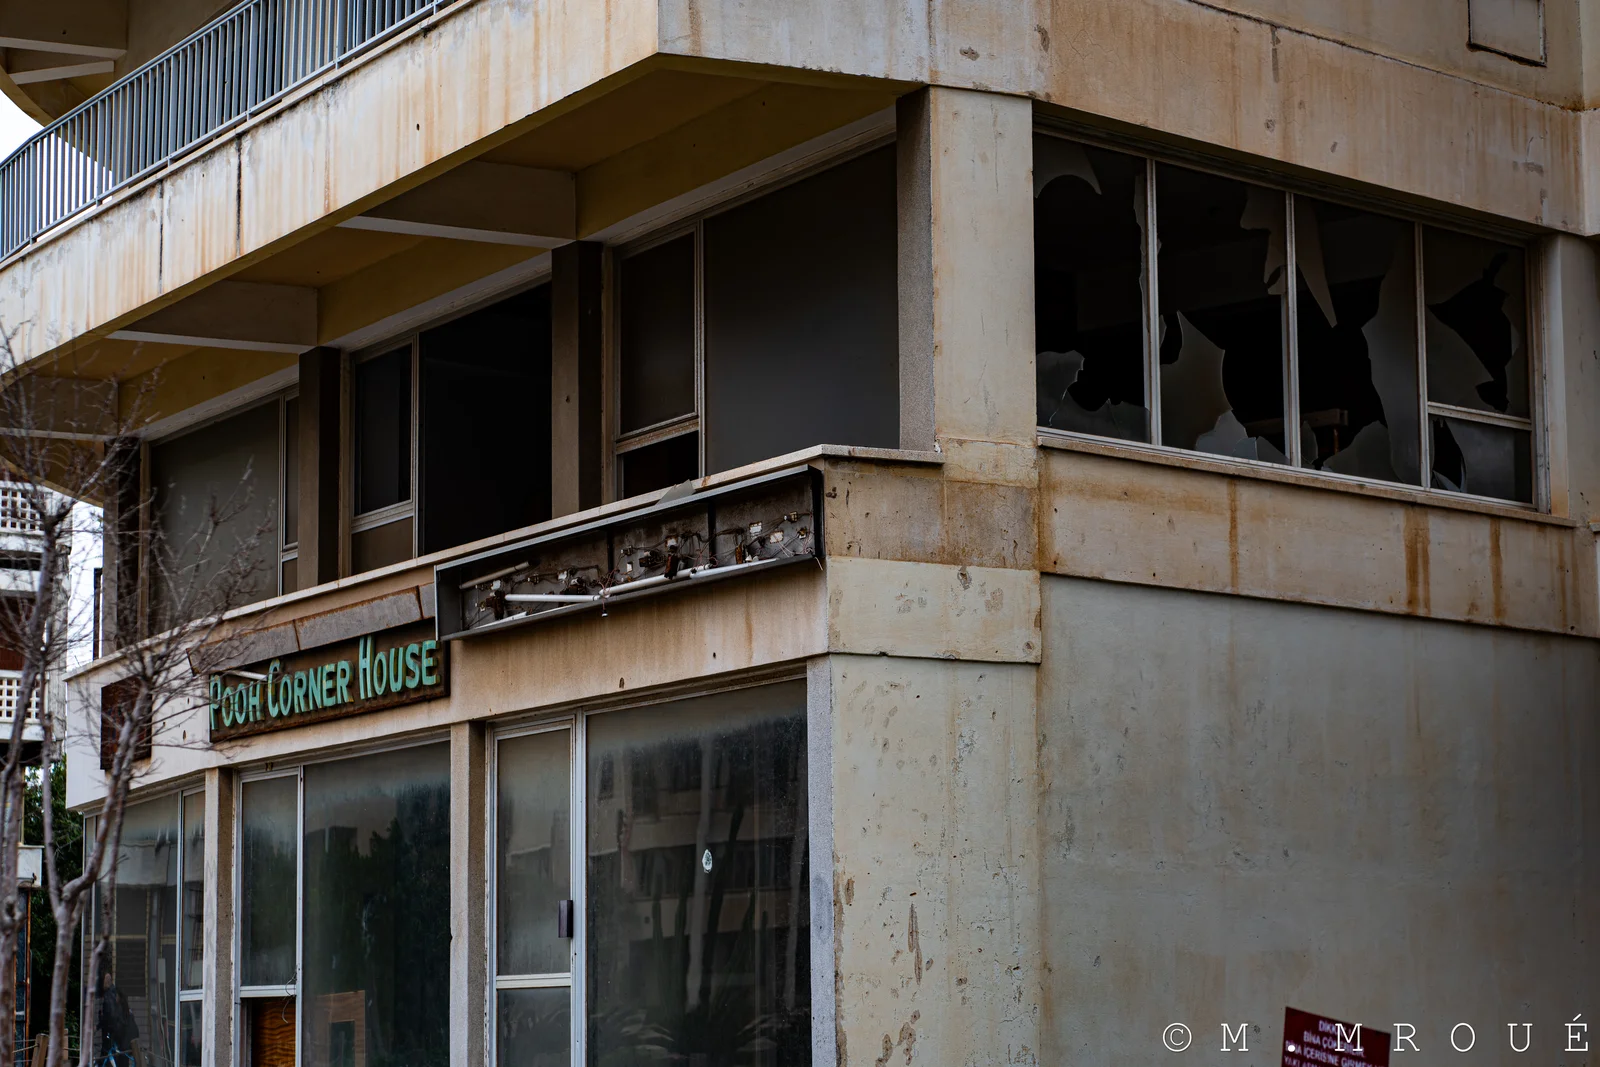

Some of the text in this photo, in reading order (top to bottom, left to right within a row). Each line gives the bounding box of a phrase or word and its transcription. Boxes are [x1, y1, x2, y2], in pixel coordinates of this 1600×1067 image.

[210, 634, 440, 730] POOH CORNER HOUSE
